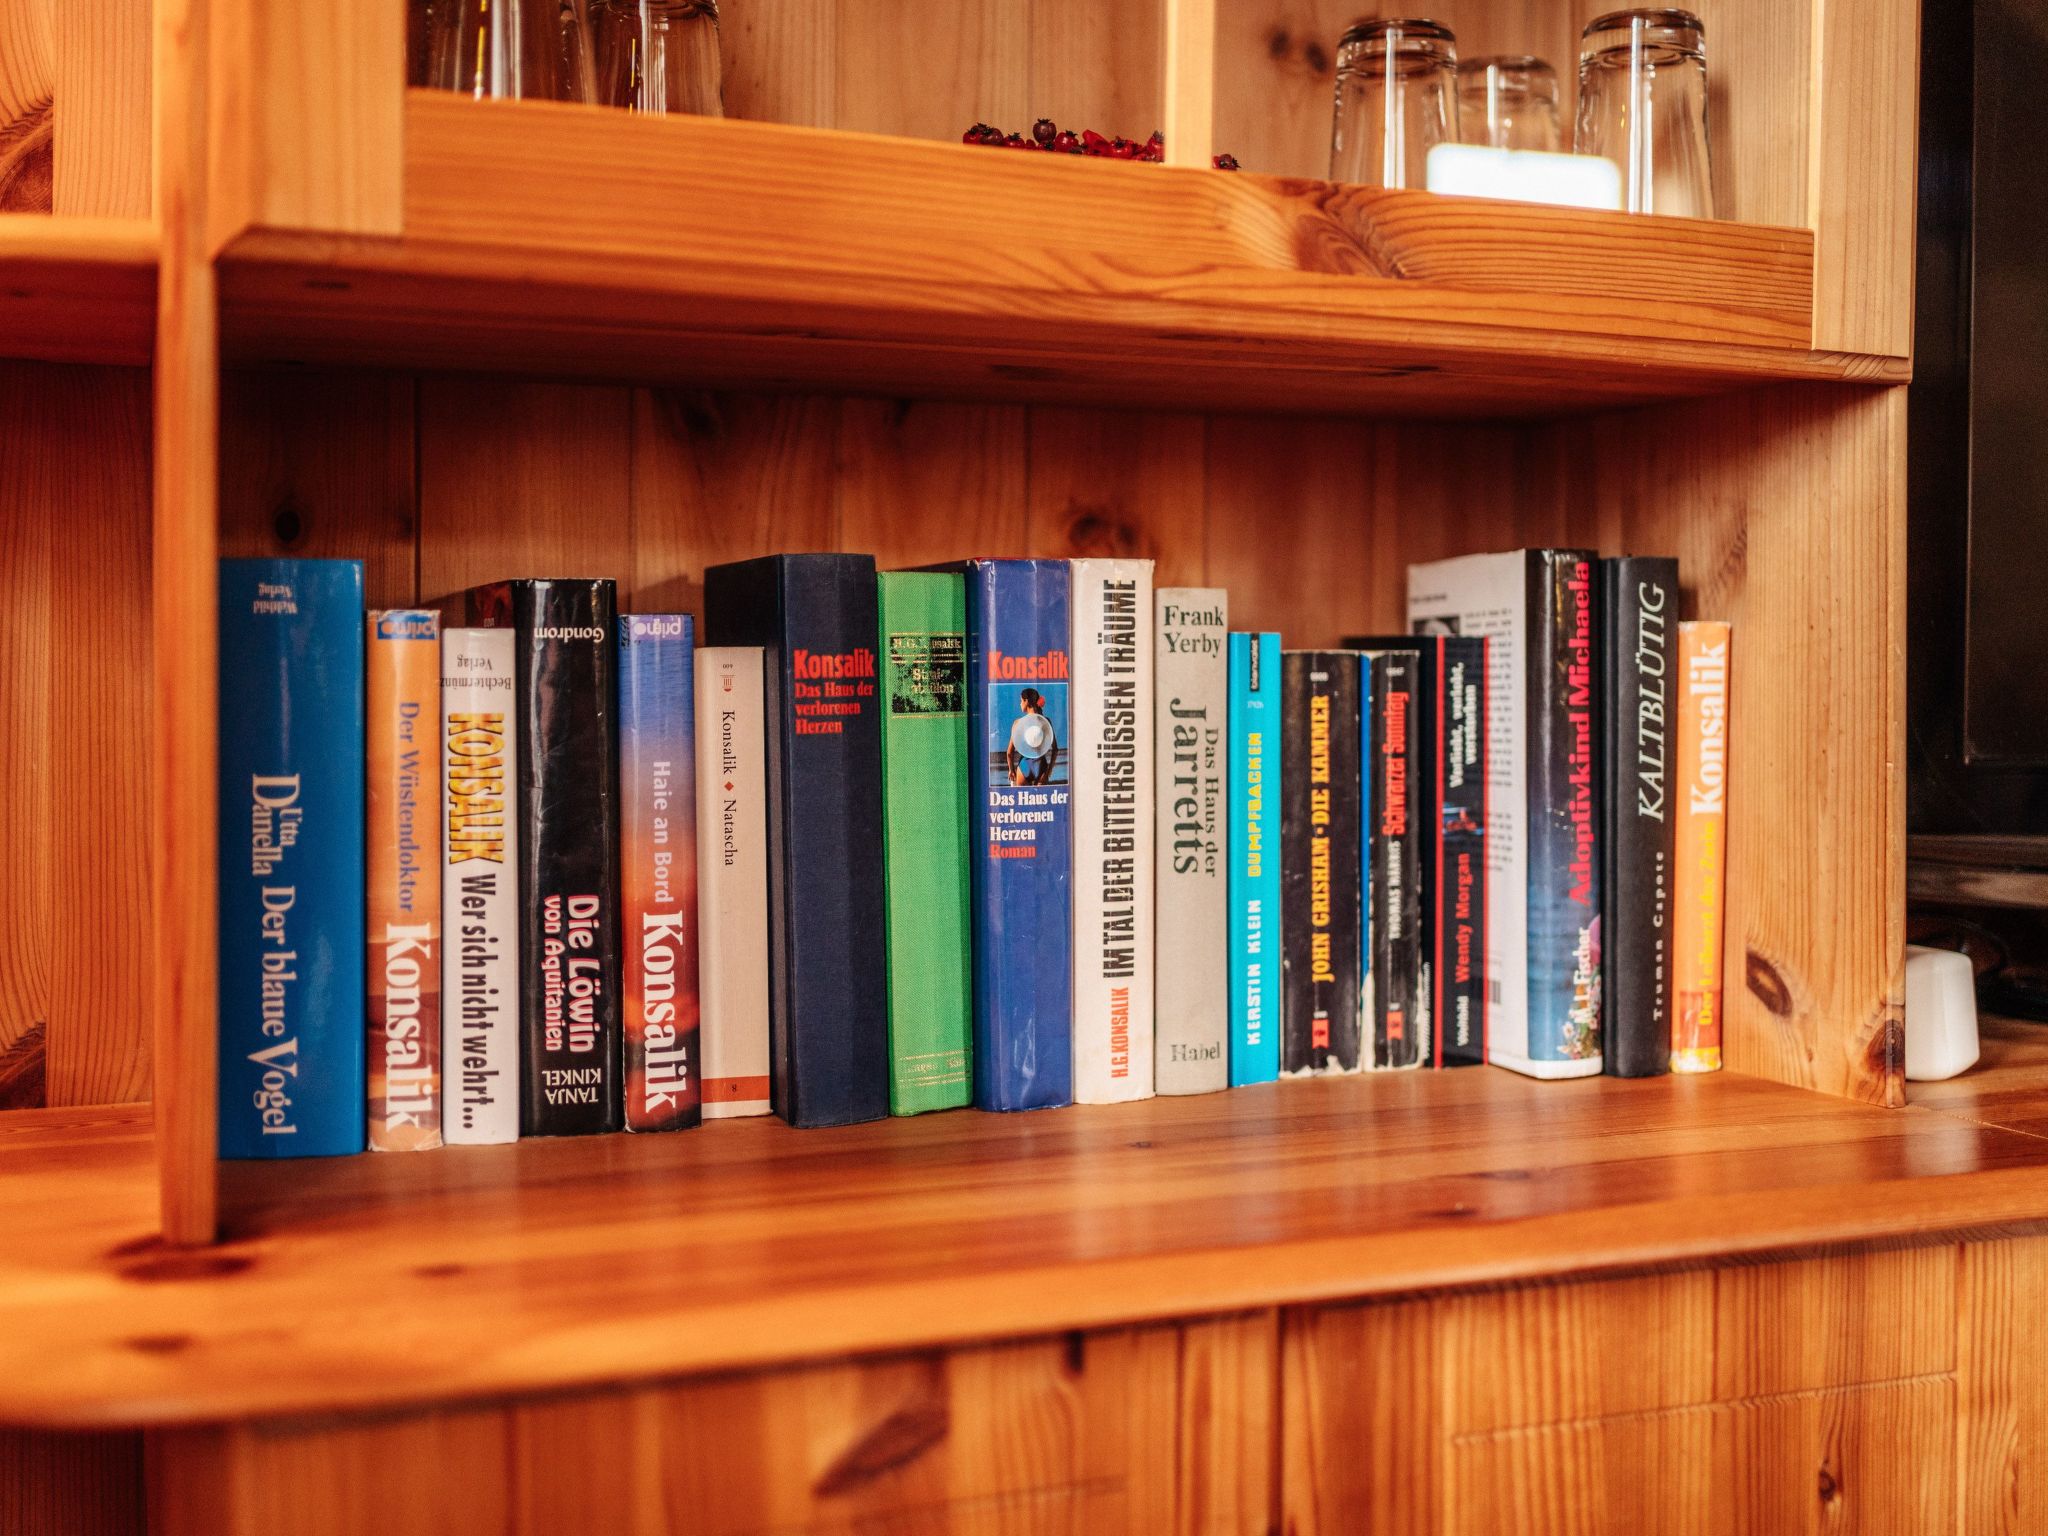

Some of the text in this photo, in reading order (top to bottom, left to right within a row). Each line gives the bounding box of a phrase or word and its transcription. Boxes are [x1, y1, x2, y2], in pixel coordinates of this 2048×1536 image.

[381, 618, 435, 638] primo
[534, 626, 605, 643] Gondrom
[634, 616, 682, 637] primo
[1163, 605, 1225, 627] Frank
[1166, 633, 1222, 659] Yerby
[440, 676, 512, 691] Bechtermünz
[457, 655, 493, 671] Verlag
[794, 650, 874, 679] Konsalik
[795, 680, 873, 698] Das Haus der
[988, 650, 1070, 680] Konsalik
[1636, 582, 1665, 823] KALTBLÜTIG
[795, 699, 861, 717] verlorenen
[795, 717, 843, 735] Herzen
[1311, 694, 1330, 784] KAMMER
[1383, 691, 1410, 754] Sonntag
[1568, 562, 1594, 906] Adoptivkind Michaela
[1690, 641, 1727, 817] Konsalik
[399, 702, 420, 913] Der Wüstendoktor
[448, 713, 504, 865] KONSALIK
[722, 710, 738, 867] Konsalik Natascha
[989, 788, 1068, 807] Das Haus der
[989, 808, 1054, 824] verlorenen
[1097, 580, 1136, 978] IM TAL DER BITTERSÜSSEN TRÄUME
[1170, 697, 1207, 874] Jarretts
[1205, 728, 1219, 877] Das Haus der
[1247, 733, 1262, 877] DUMPFBACKEN
[1311, 788, 1330, 825] DIE
[1383, 755, 1407, 836] Schwarzer
[252, 772, 300, 876] Danella
[652, 760, 674, 903] Haie an Bord
[989, 826, 1036, 842] Herzen
[989, 844, 1036, 859] Roman
[1311, 838, 1331, 926] GRISHAM
[1387, 889, 1401, 939] THOMAS
[1456, 853, 1473, 983] Wendy Morgan
[541, 895, 566, 1052] von Aquitanien
[568, 895, 601, 1053] Die Löwin
[1247, 900, 1261, 1044] KERSTIN KLEIN
[1311, 934, 1335, 982] JOHN
[1572, 927, 1591, 985] Fischer
[1652, 852, 1666, 1021] Truman Capote
[247, 886, 298, 1135] Der blaue Vogel
[385, 922, 433, 1133] Konsalik
[461, 873, 499, 1130] Wer sich nicht wehrt...
[643, 912, 687, 1113] Konsalik
[1111, 987, 1130, 1078] H.G.KONSALIK
[542, 1070, 602, 1086] KINKEL
[1171, 1042, 1221, 1063] Habel
[545, 1088, 599, 1104] TANJA
